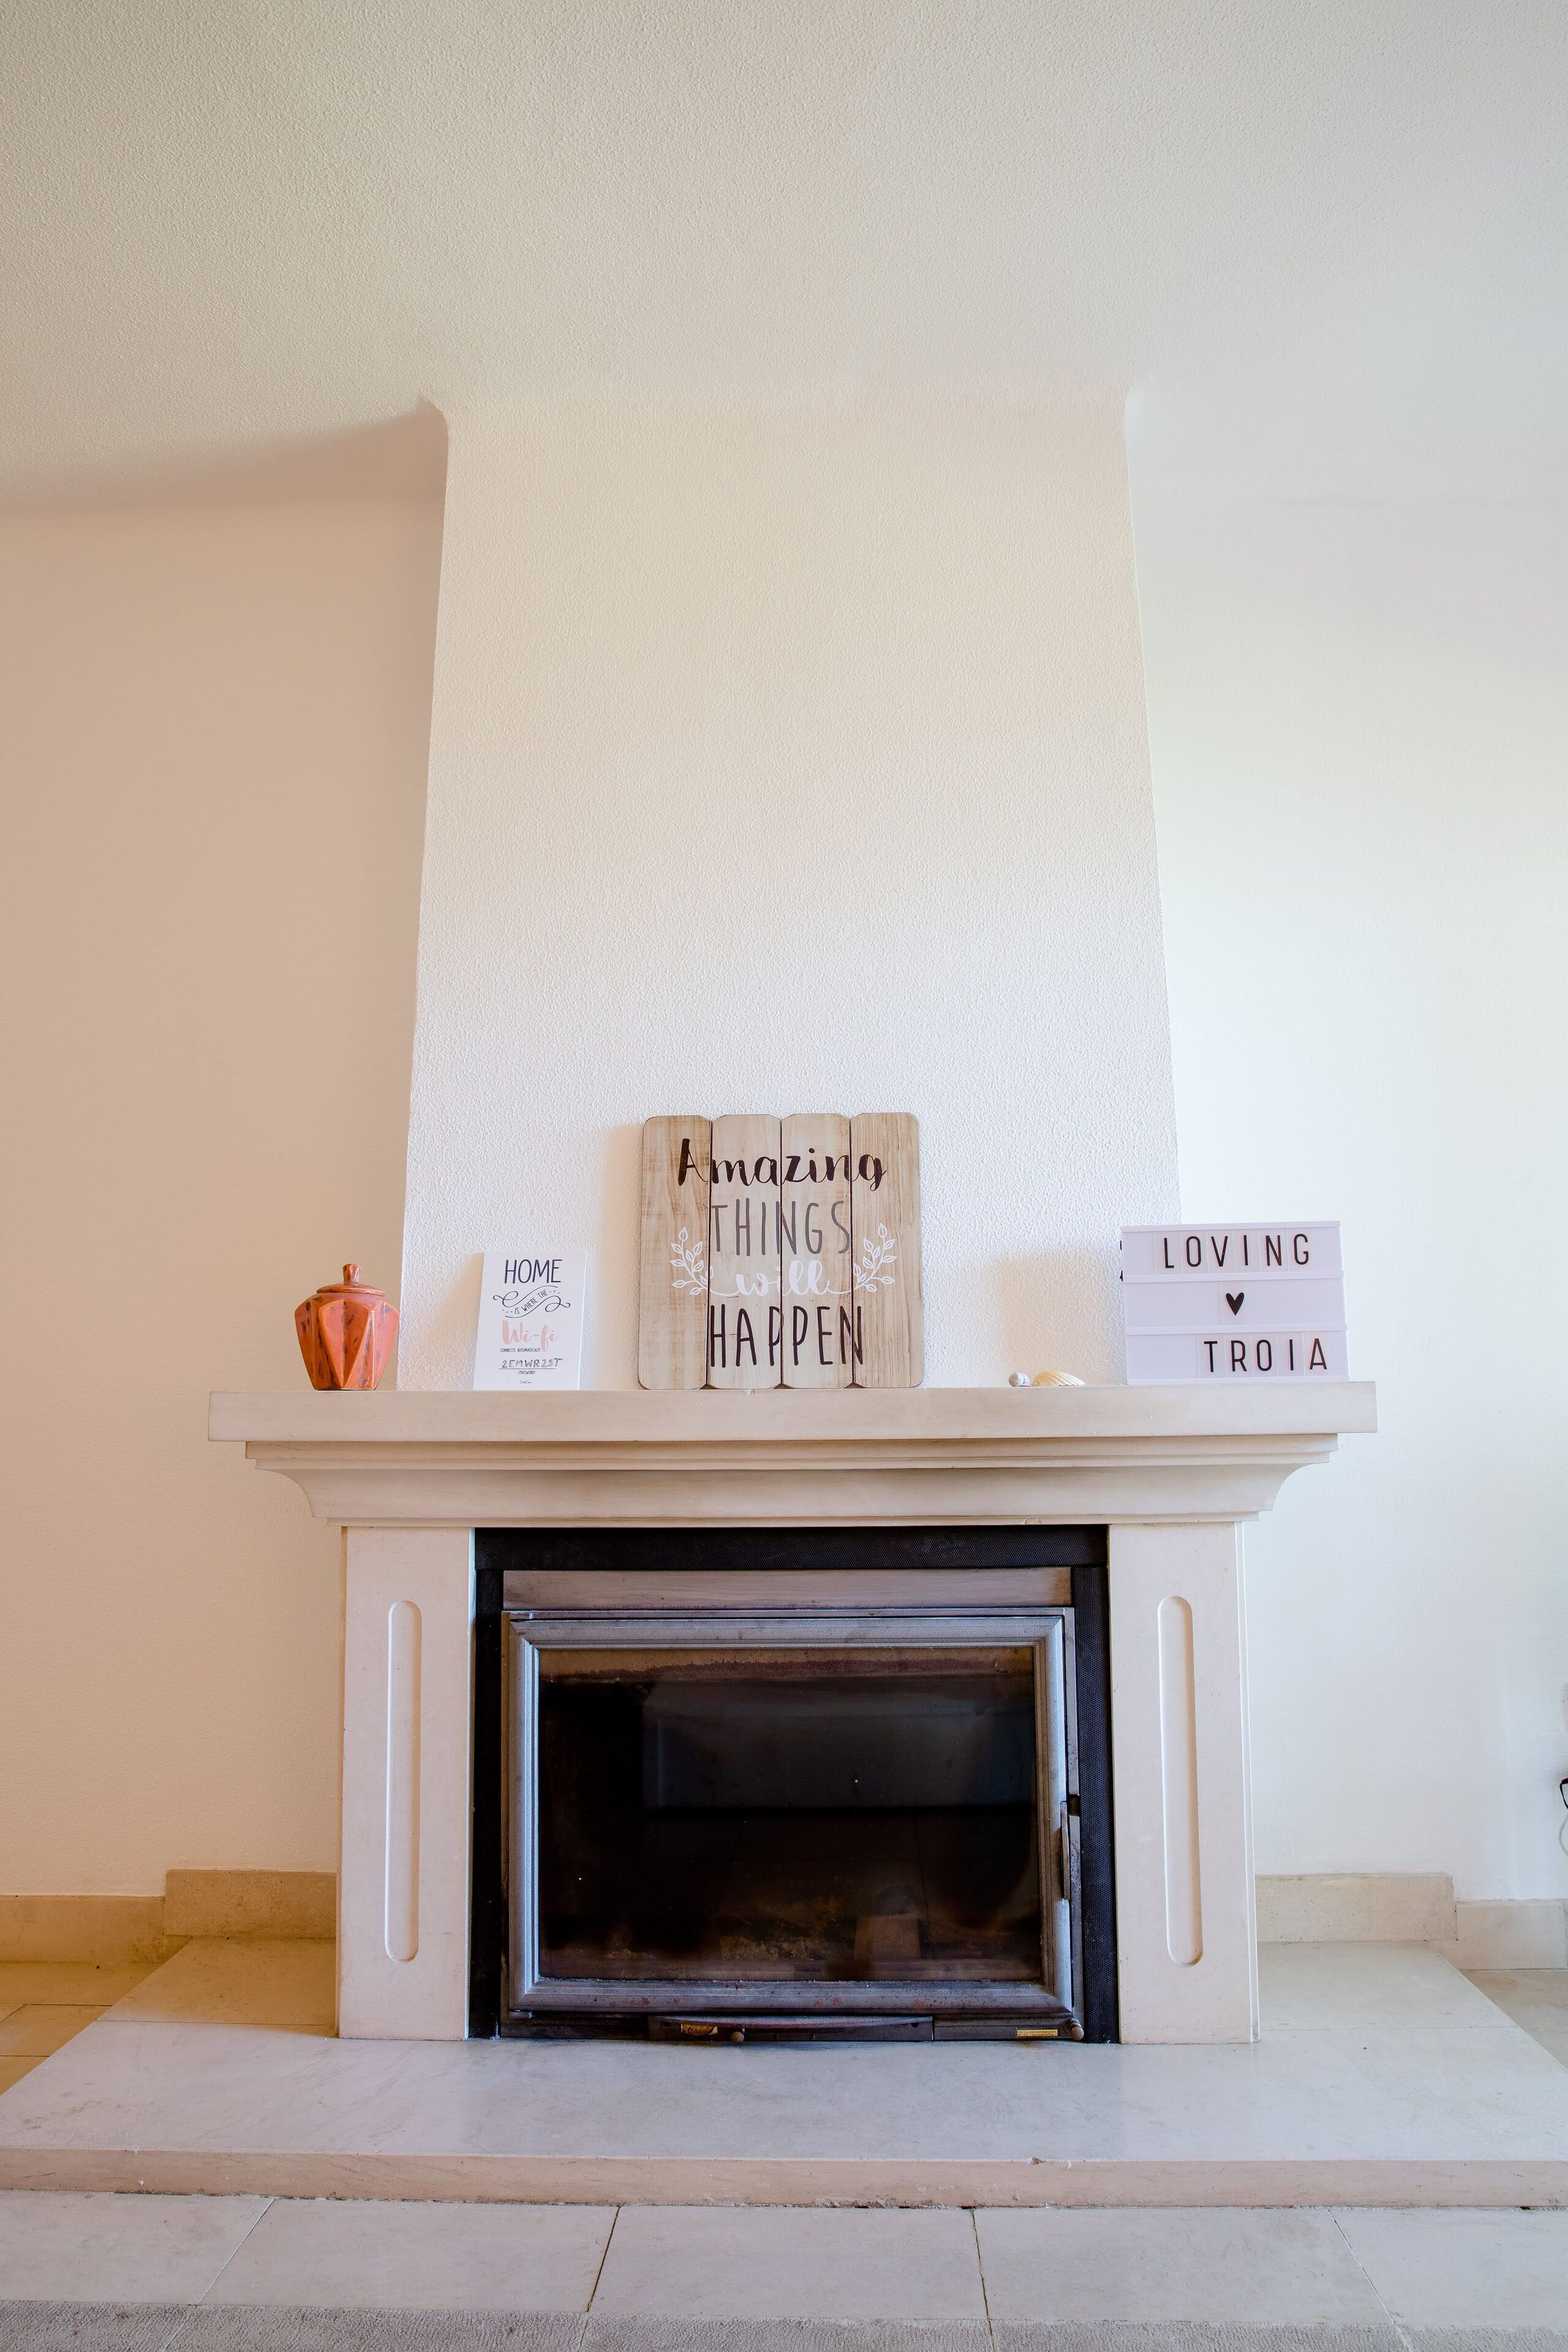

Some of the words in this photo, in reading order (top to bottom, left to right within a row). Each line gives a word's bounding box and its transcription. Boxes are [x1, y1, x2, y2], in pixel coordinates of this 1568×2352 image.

[677, 1138, 887, 1191] Amazing
[711, 1197, 850, 1256] THINGS
[1164, 1234, 1309, 1268] LOVING
[504, 1259, 562, 1284] HOME
[736, 1260, 830, 1296] will
[521, 1297, 538, 1312] WHERE
[502, 1320, 559, 1352] Wi-fi
[710, 1303, 863, 1367] HAPPEN
[1204, 1338, 1327, 1373] TROIA
